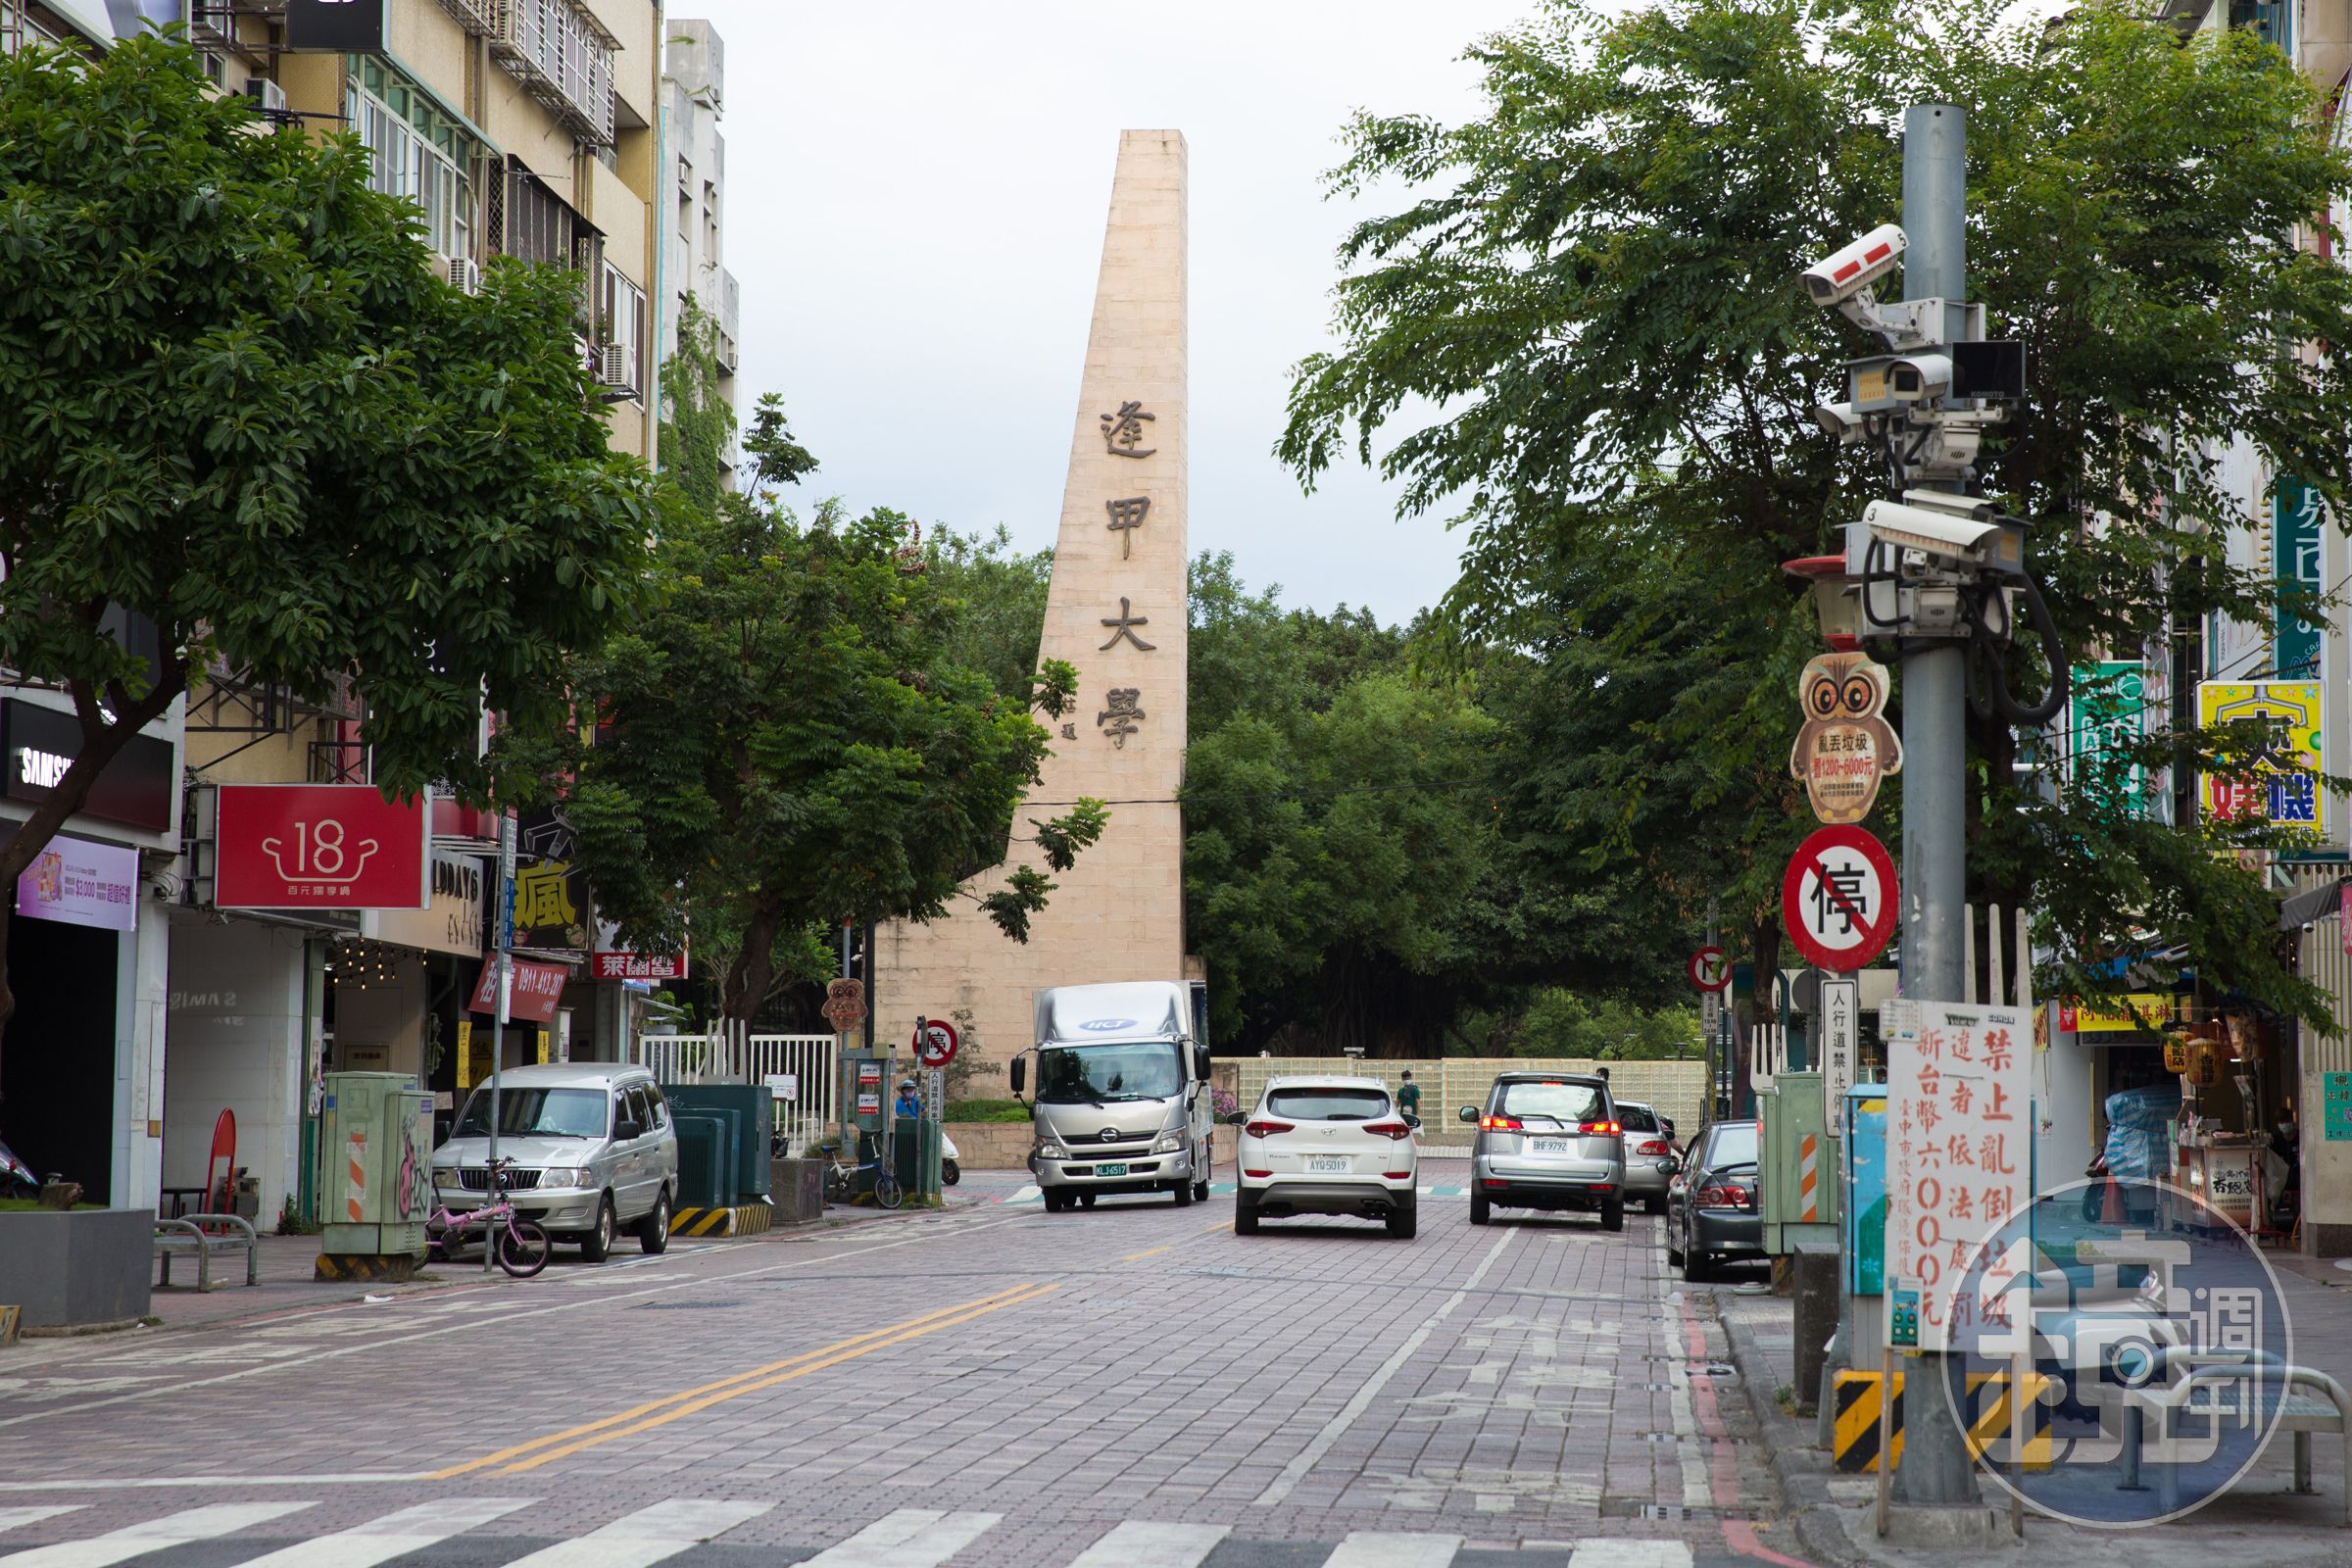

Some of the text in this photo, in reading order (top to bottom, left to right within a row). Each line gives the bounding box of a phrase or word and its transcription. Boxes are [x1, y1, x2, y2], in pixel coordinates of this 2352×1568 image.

[1868, 509, 1877, 521] 3
[1098, 401, 1156, 749] 逢甲大學
[1818, 734, 1868, 753] 亂丟垃圾
[1810, 862, 1867, 934] 停
